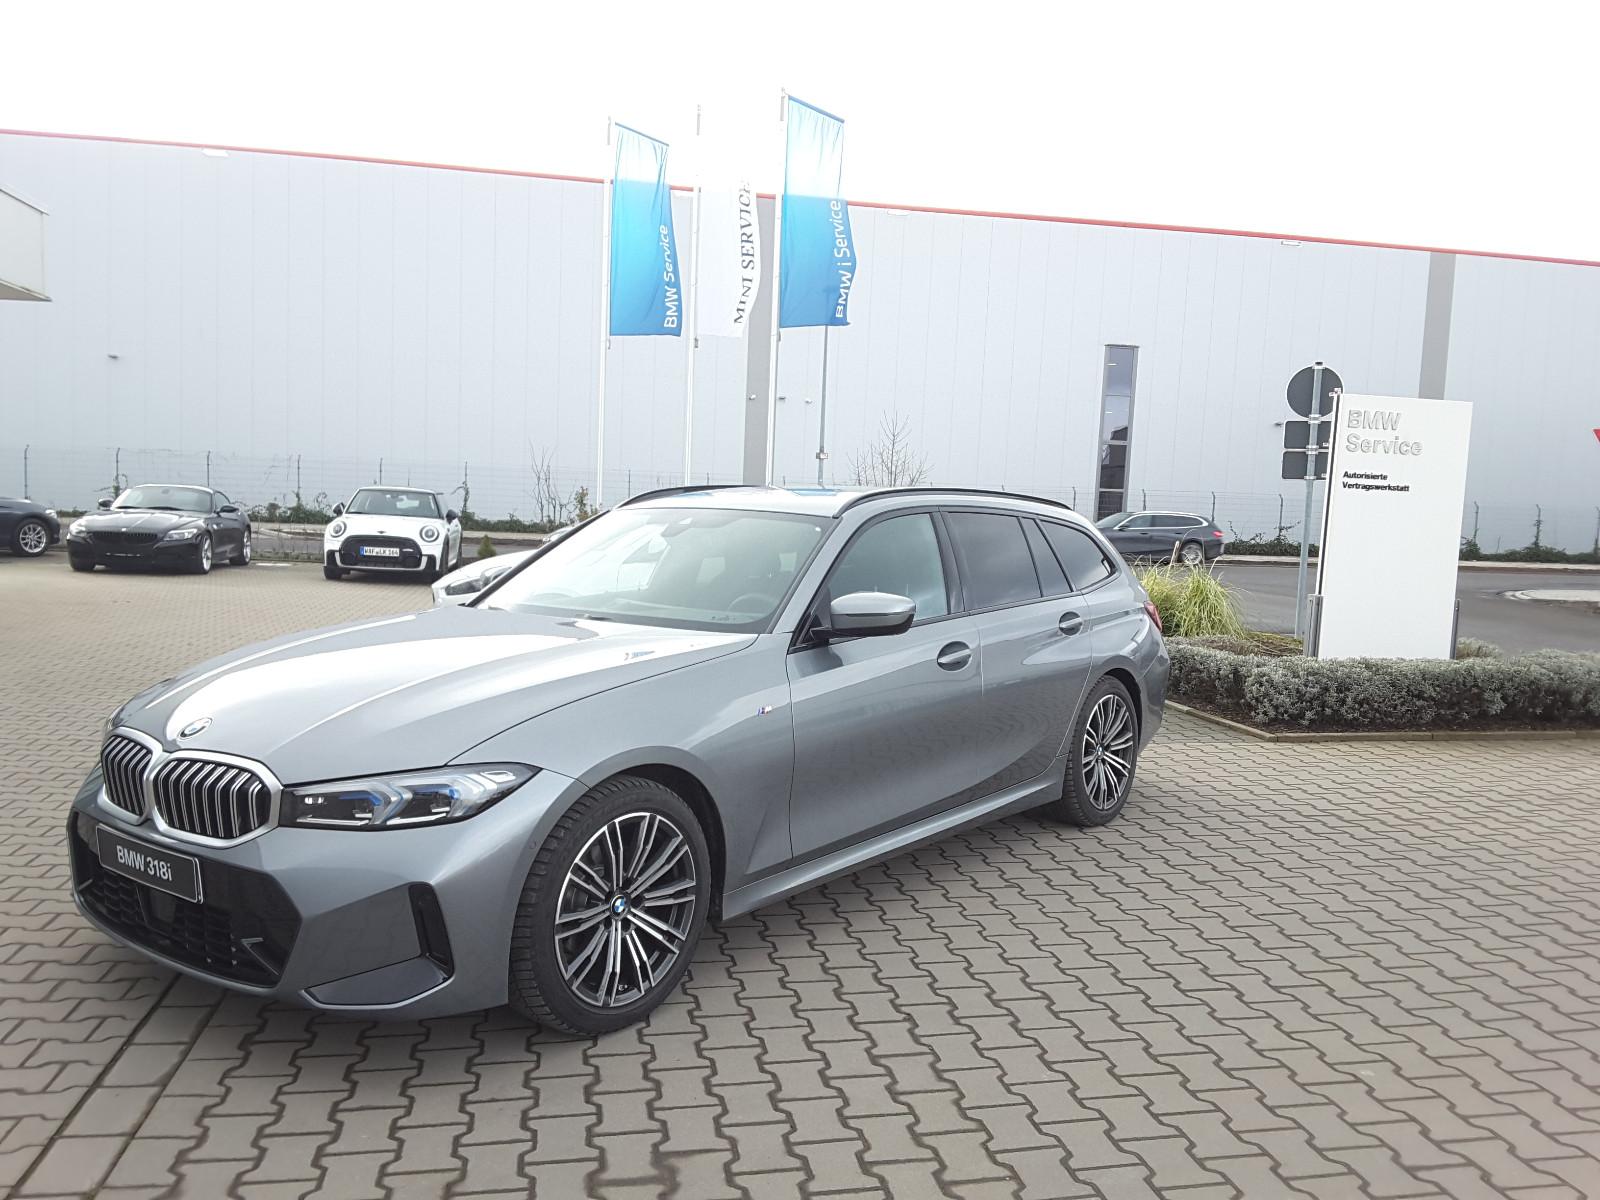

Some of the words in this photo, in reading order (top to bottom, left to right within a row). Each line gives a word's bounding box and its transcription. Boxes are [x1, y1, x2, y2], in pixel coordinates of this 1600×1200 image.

[831, 200, 850, 258] Service
[660, 224, 675, 281] Service
[663, 286, 678, 328] BMW
[734, 276, 753, 324] MINI
[835, 271, 852, 318] BMW
[1347, 409, 1401, 431] BMW
[1345, 432, 1423, 456] Service
[1342, 470, 1388, 481] Autorisierte
[1342, 481, 1410, 492] Vertragswerkstatt
[116, 845, 145, 872] BMW
[147, 857, 172, 881] 318i
